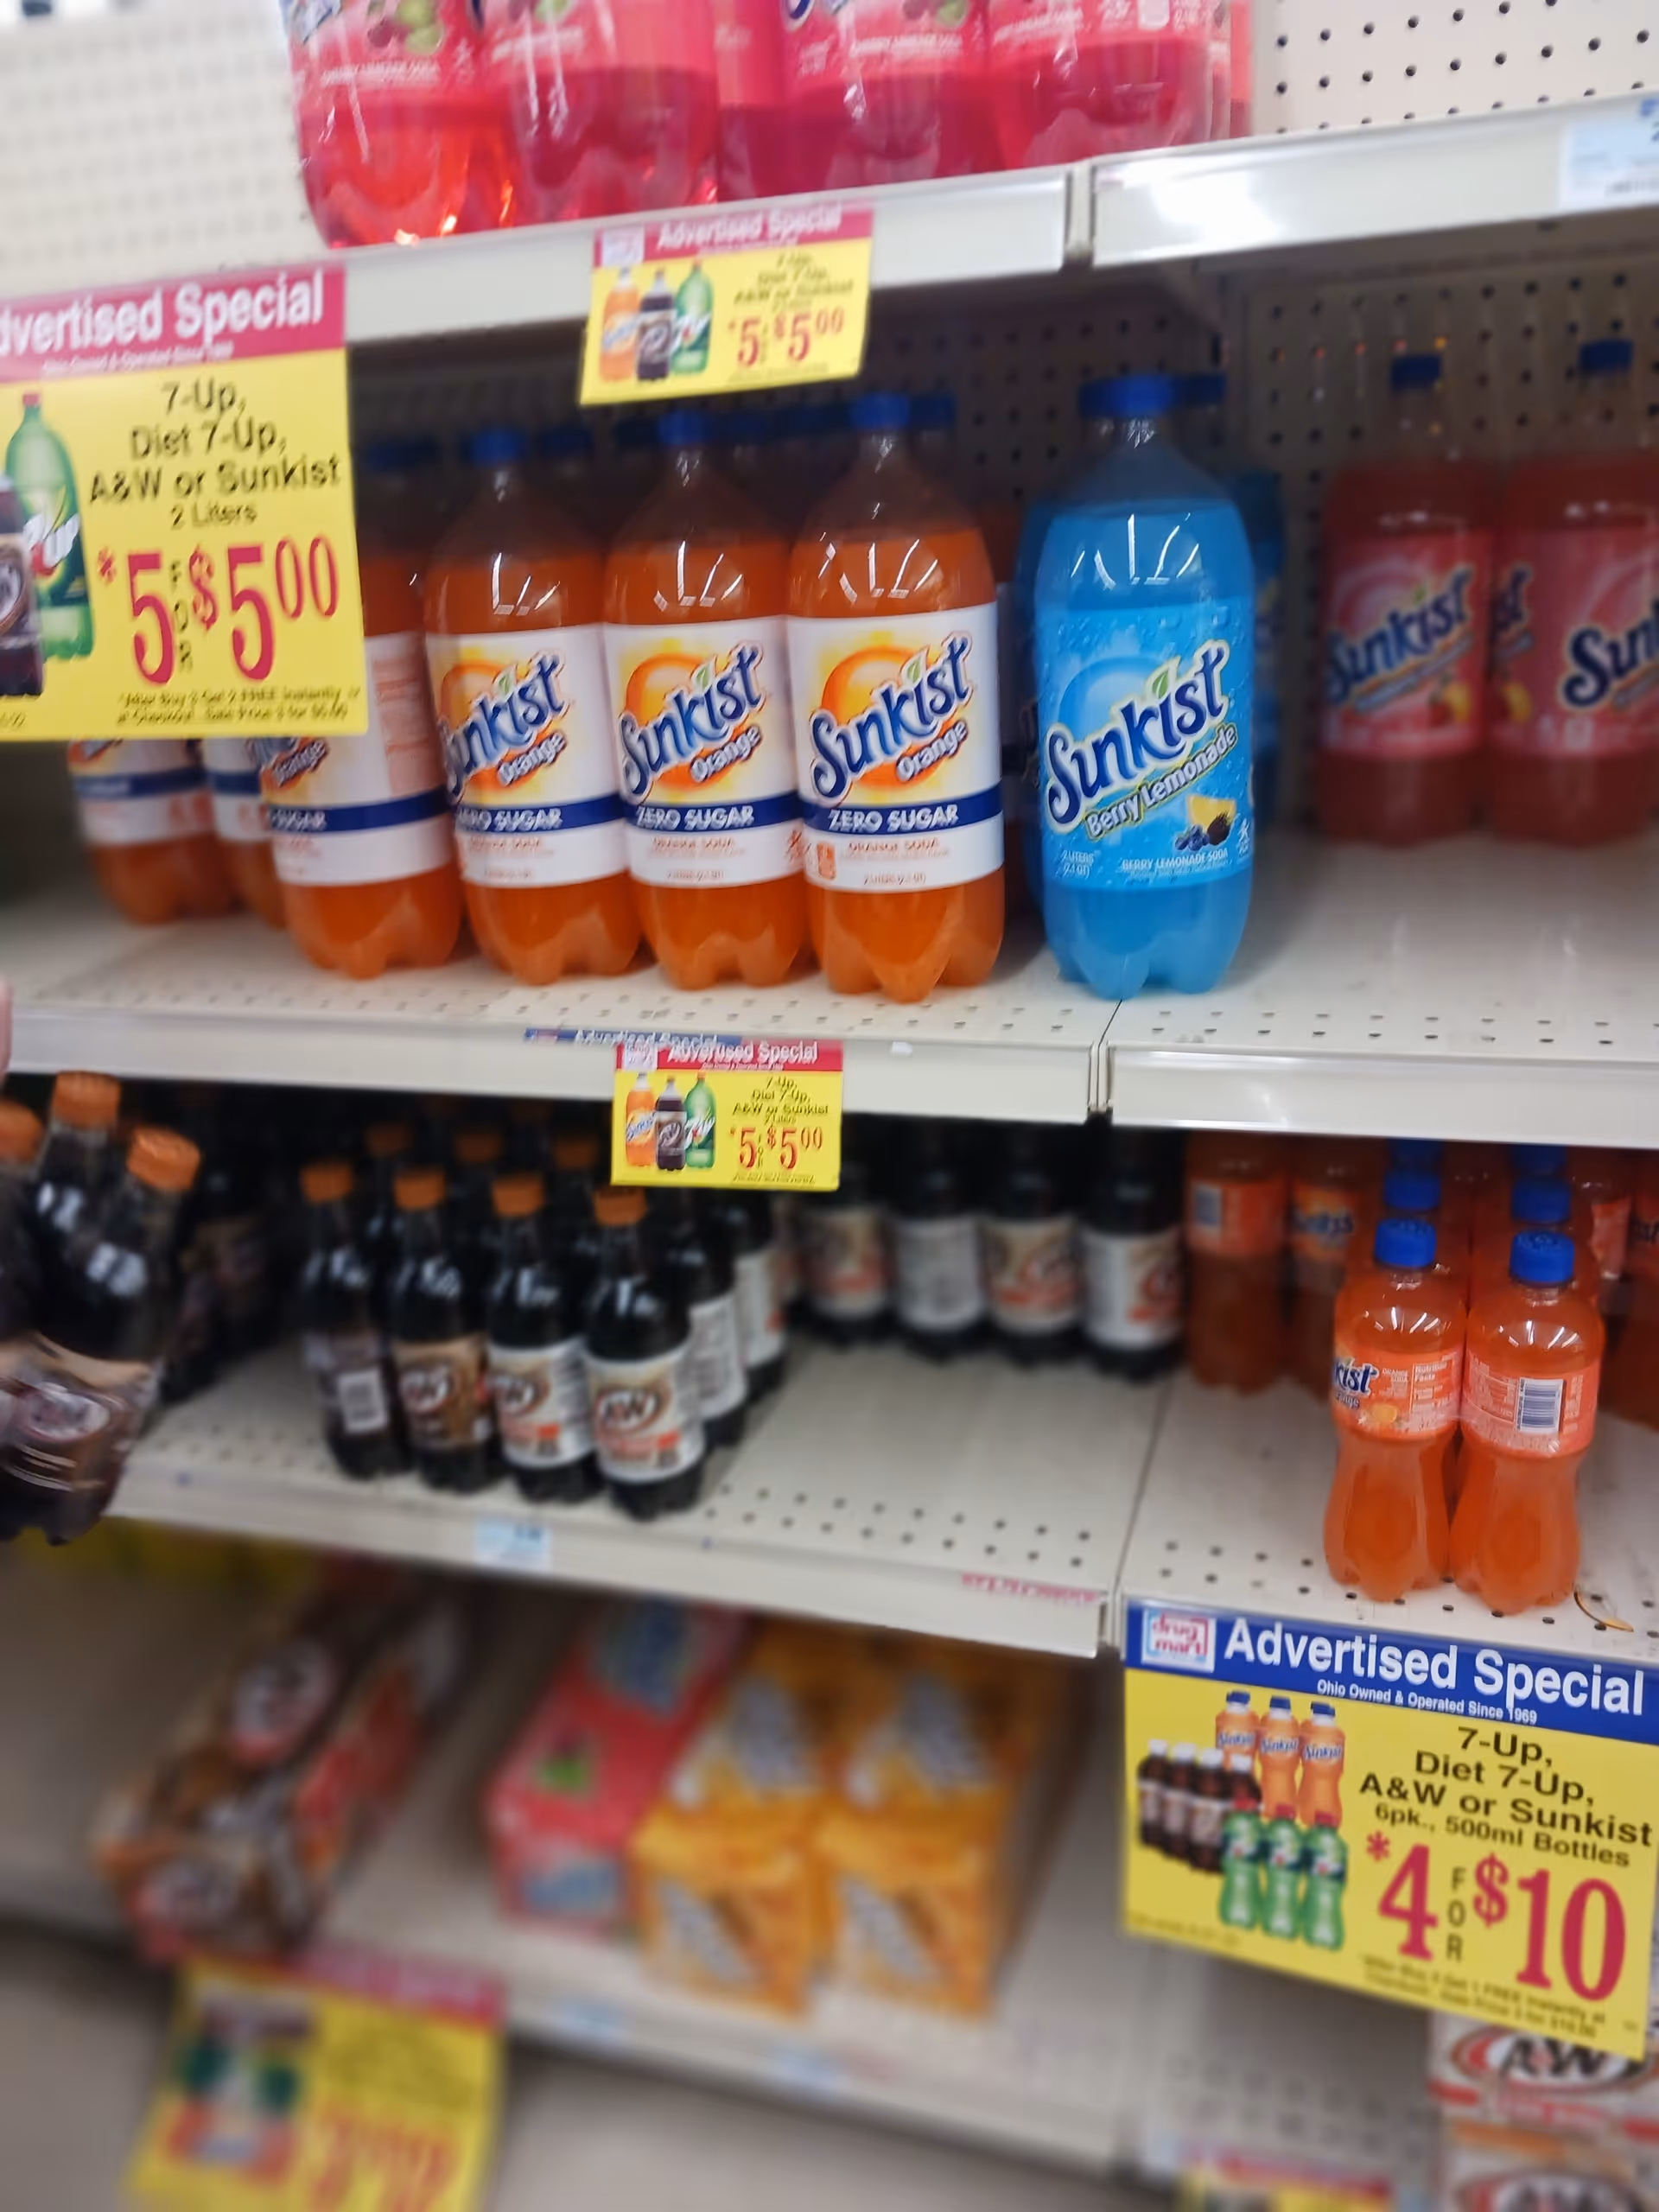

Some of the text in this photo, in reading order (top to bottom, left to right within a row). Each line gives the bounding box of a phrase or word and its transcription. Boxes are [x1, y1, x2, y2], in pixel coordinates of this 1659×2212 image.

[0, 268, 324, 356] dvertised Special
[162, 378, 246, 416] 7-Up,
[131, 426, 189, 461] Diet
[90, 454, 340, 503] A&W or Sunkist
[171, 502, 257, 529] 2 Liters
[1327, 567, 1472, 705] Sunkist
[620, 645, 760, 794] Sunkist
[813, 637, 970, 798] Sunkist
[1047, 646, 1224, 825] Sunkist
[499, 733, 567, 786] Orange
[691, 726, 762, 781] Orange
[896, 721, 968, 782] Orange
[1086, 724, 1237, 840] Berry Lemonade
[494, 807, 563, 832] SUGAR
[637, 805, 754, 831] ZERO SUGAR
[828, 804, 958, 834] ZERO SUGAR
[1122, 858, 1154, 871] BERRY
[759, 1040, 817, 1065] Special
[1225, 1617, 1643, 1716] Advertised Special
[1318, 1679, 1537, 1725] Ohio Owned & Operated Since 1969
[1458, 1726, 1552, 1767] 7-Up,
[1415, 1750, 1594, 1806] Diet 7-Up,
[1359, 1772, 1654, 1847] A&W or Sunkist
[1446, 1815, 1523, 1847] 500ml
[1533, 1831, 1630, 1867] Bottles
[1471, 1852, 1627, 2003] $10
[1499, 2034, 1604, 2078] A&W
